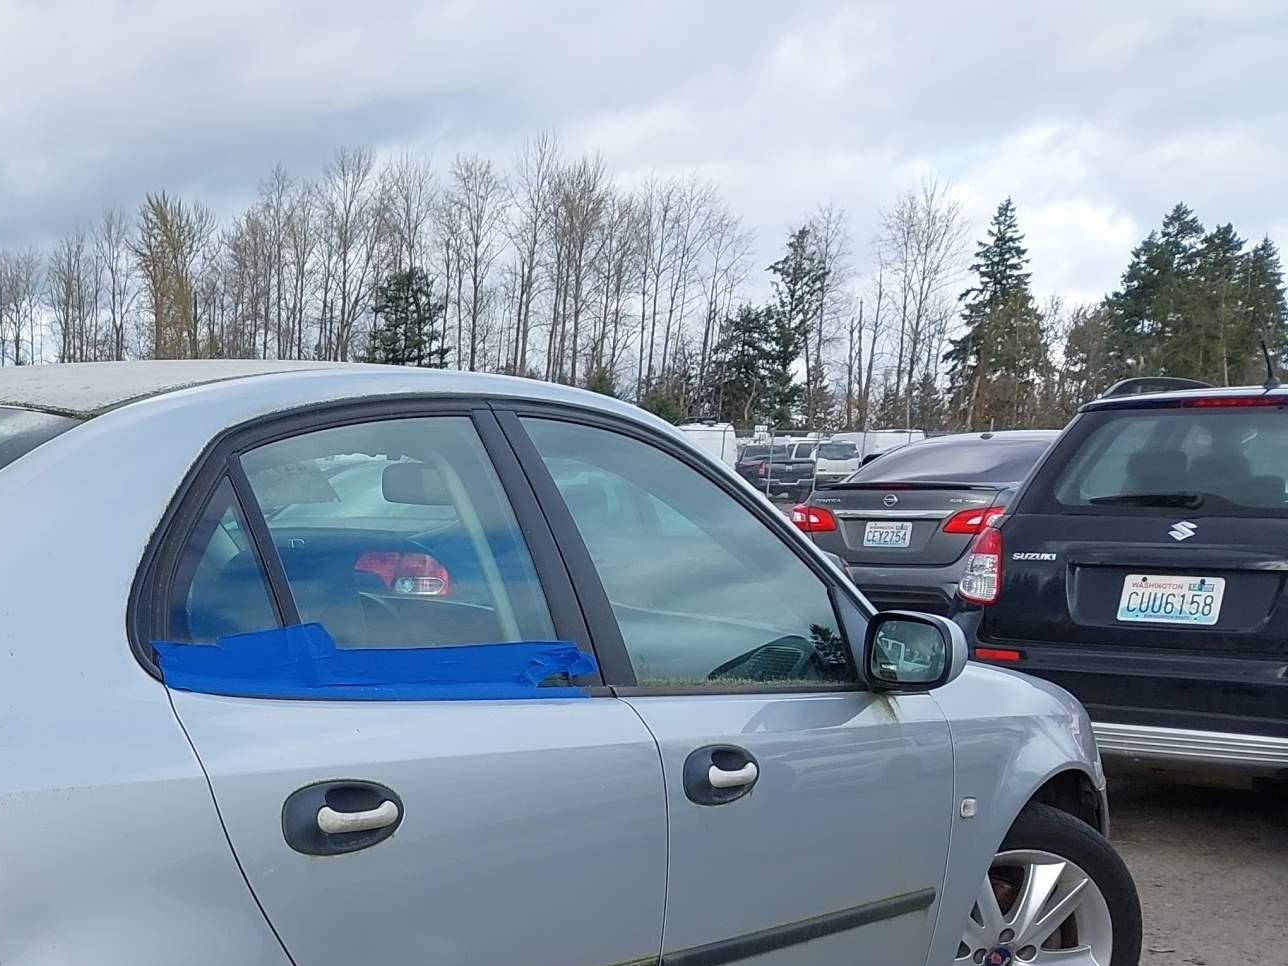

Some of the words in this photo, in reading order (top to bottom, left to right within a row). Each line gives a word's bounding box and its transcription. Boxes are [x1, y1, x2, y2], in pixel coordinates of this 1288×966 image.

[1012, 552, 1057, 561] SUZUKI
[1131, 582, 1184, 590] WASHINGTON
[1126, 591, 1215, 617] CUU6158
